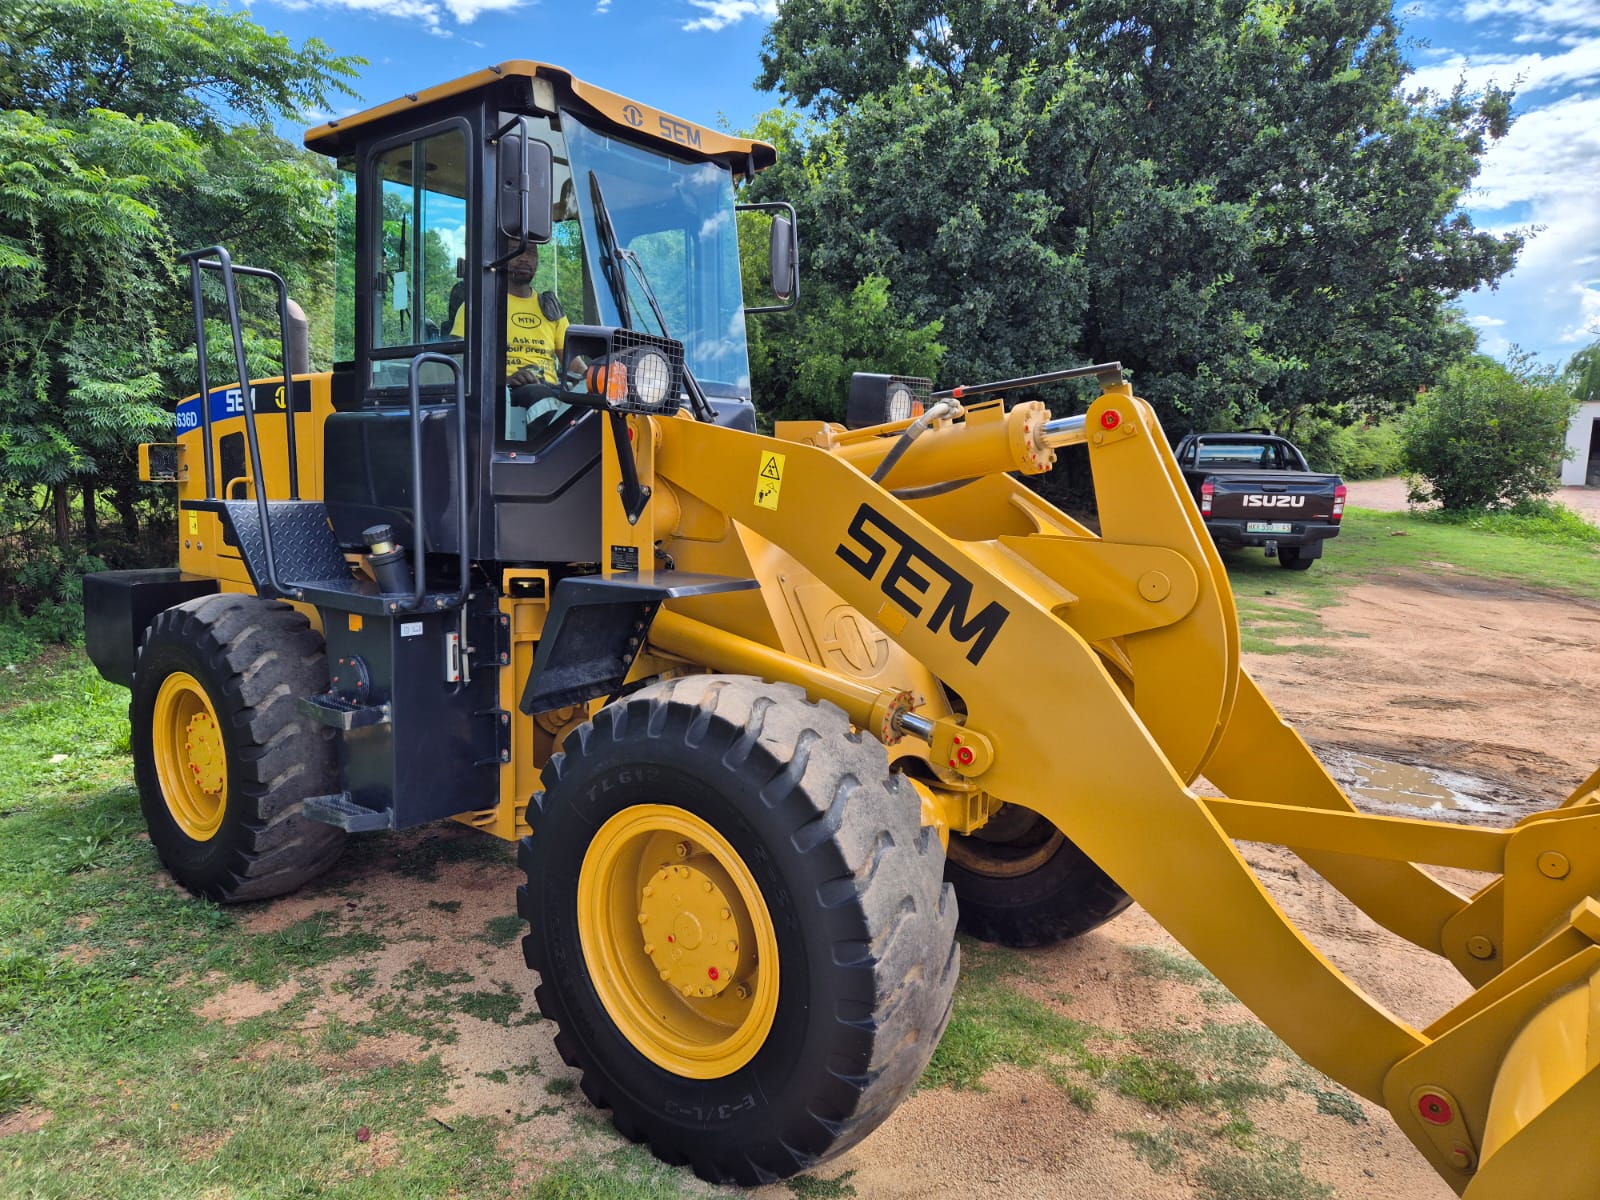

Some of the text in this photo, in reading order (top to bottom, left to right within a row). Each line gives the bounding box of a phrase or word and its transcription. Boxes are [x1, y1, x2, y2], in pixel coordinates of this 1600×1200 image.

[659, 116, 702, 149] SEM
[513, 336, 530, 344] Ask
[507, 345, 546, 355] out prep
[176, 411, 198, 428] 636D
[1242, 495, 1305, 507] ISUZU
[835, 502, 1010, 666] SEM
